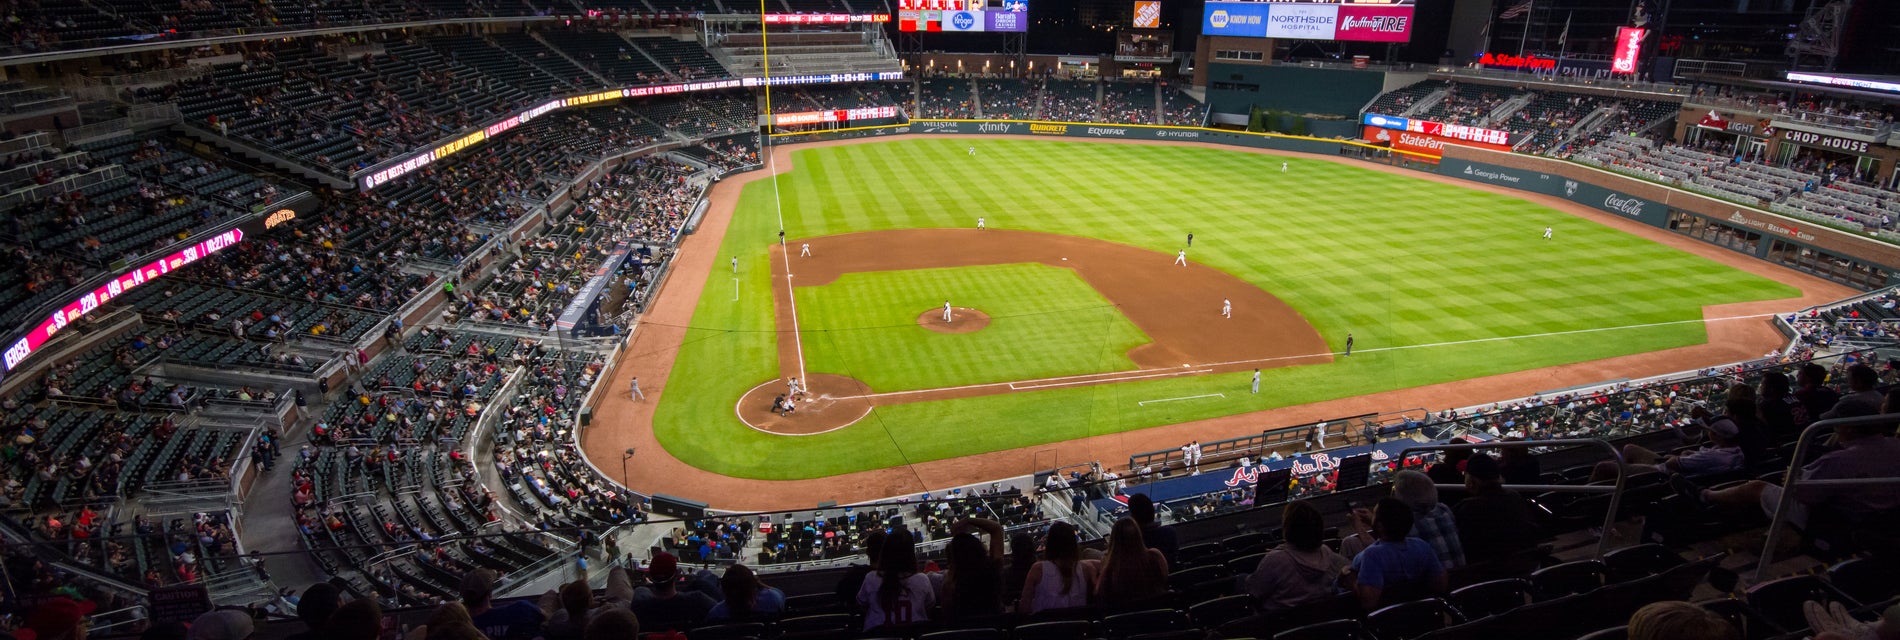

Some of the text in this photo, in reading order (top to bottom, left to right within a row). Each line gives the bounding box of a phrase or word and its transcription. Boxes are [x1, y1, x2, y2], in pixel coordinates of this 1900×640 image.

[954, 14, 973, 29] Kroger
[1213, 14, 1227, 24] NAPA
[1230, 15, 1262, 24] KNOW HOW
[1271, 15, 1334, 24] NORTHSIDE
[1340, 16, 1382, 30] Kauffman
[1372, 16, 1407, 32] TIRE
[1525, 55, 1556, 70] Farm
[630, 86, 648, 96] CLICK
[654, 85, 662, 93] OR
[663, 84, 683, 94] TICKET!
[689, 82, 701, 91] SEAT
[702, 81, 715, 90] BELTS
[715, 80, 728, 88] SAVE
[728, 79, 741, 88] LIVES
[579, 96, 588, 104] THE
[922, 121, 958, 129] WELLSTAR
[978, 123, 1010, 133] xfinity
[1029, 123, 1067, 132] QUIKRETE
[1727, 121, 1755, 134] LIGHT
[1087, 127, 1127, 136] EQUIFAX
[1785, 130, 1869, 152] CHOP HOUSE
[446, 143, 455, 154] THE
[374, 171, 388, 185] SEAT
[387, 164, 404, 179] BELTS
[403, 159, 416, 172] SAVE
[416, 154, 430, 167] LIVES
[1474, 168, 1520, 183] Georgia Power
[1604, 193, 1646, 216] Coca-Cola
[53, 310, 67, 330] SS
[107, 279, 122, 298] 149
[132, 271, 144, 286] 14
[160, 259, 168, 274] 3
[206, 234, 223, 254] 10:27
[223, 230, 236, 246] PM
